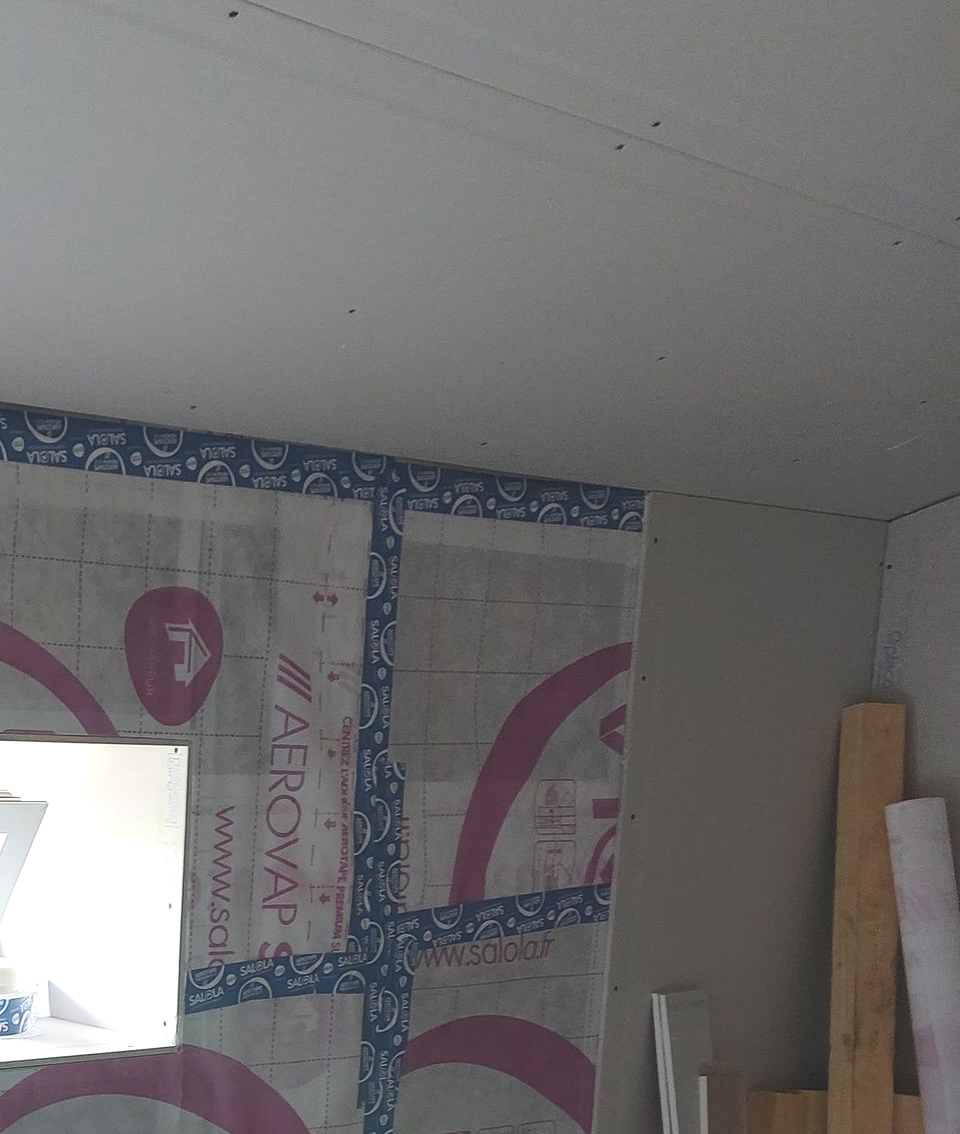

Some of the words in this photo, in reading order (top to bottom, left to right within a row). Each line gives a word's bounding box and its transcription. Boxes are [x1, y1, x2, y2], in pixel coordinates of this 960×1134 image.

[86, 432, 127, 446] SALOLA
[26, 449, 68, 464] SALOLA
[199, 446, 236, 459] SALOLA
[143, 463, 182, 477] SALOLA
[303, 459, 338, 472] SALOLA
[251, 475, 287, 488] SALOLA
[369, 619, 380, 664] SALOLA
[262, 703, 311, 927] AEROVAP
[240, 958, 275, 977] SALOLA
[287, 972, 320, 989] SALOLA
[189, 986, 225, 1007] SALOLA
